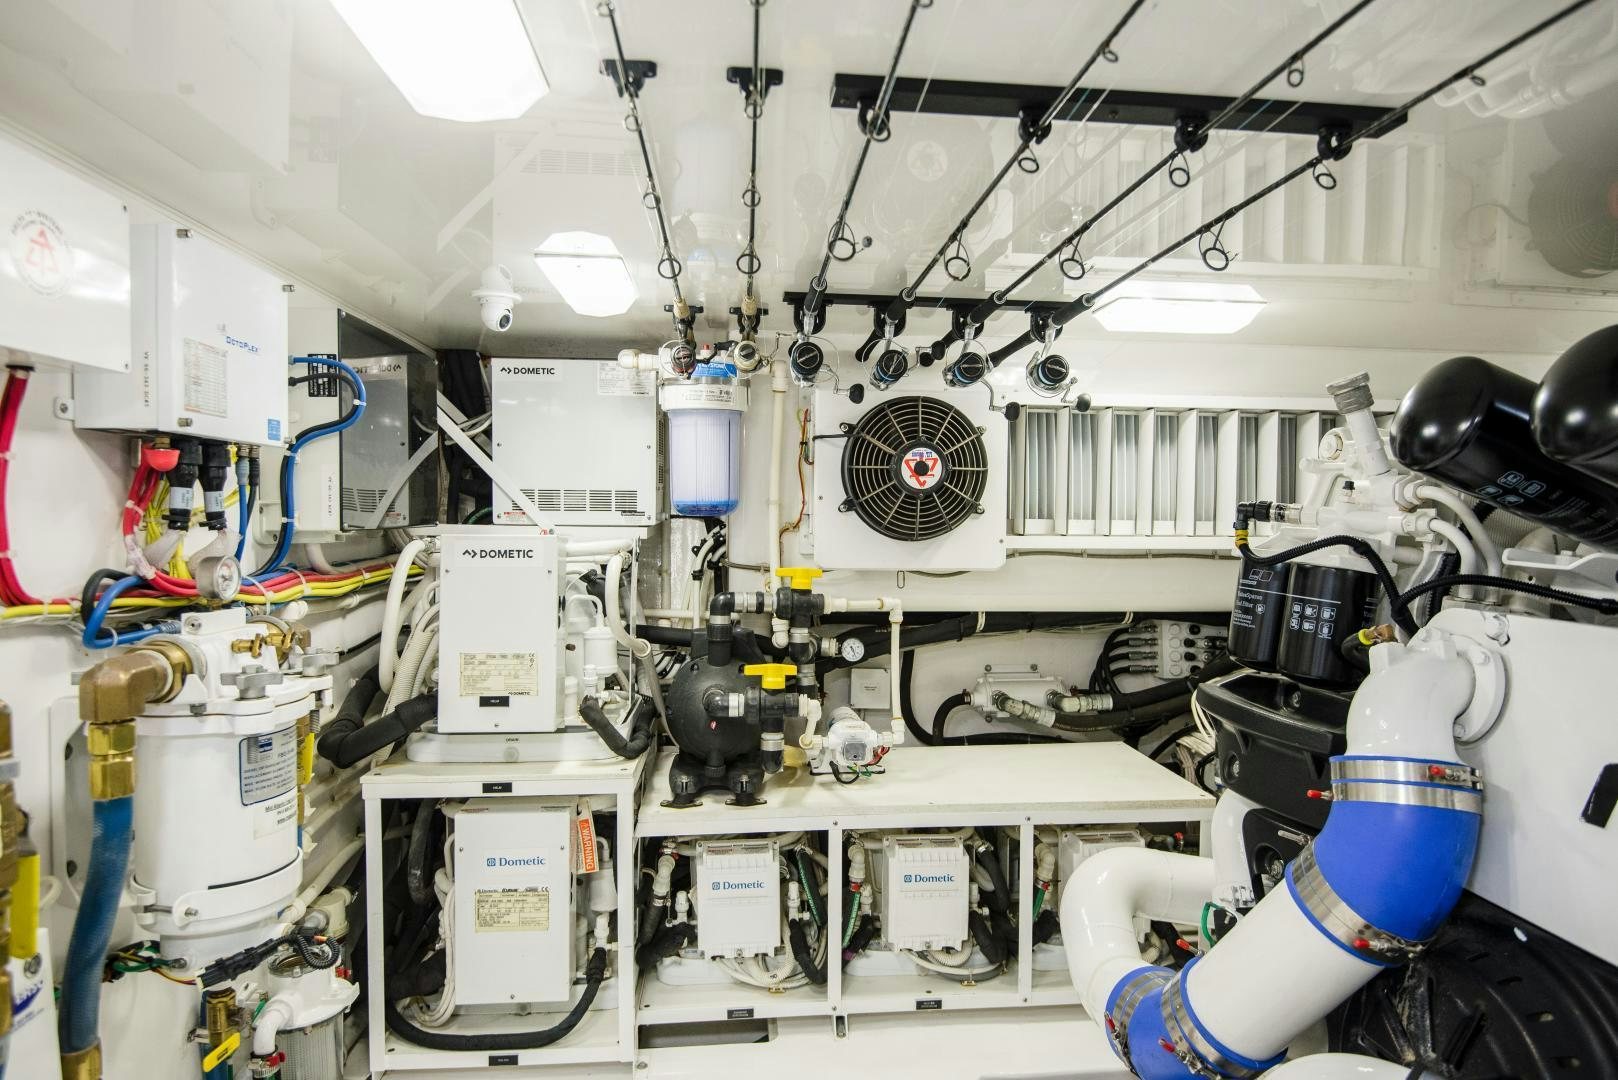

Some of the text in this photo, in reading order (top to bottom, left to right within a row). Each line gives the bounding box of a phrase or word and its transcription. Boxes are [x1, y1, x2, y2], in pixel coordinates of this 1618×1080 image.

[513, 367, 555, 375] DOMETIC
[480, 549, 534, 559] DOMETIC
[581, 826, 594, 870] WARNING
[499, 857, 545, 867] Dometic
[914, 873, 955, 884] Dometic
[722, 880, 765, 891] Dometic
